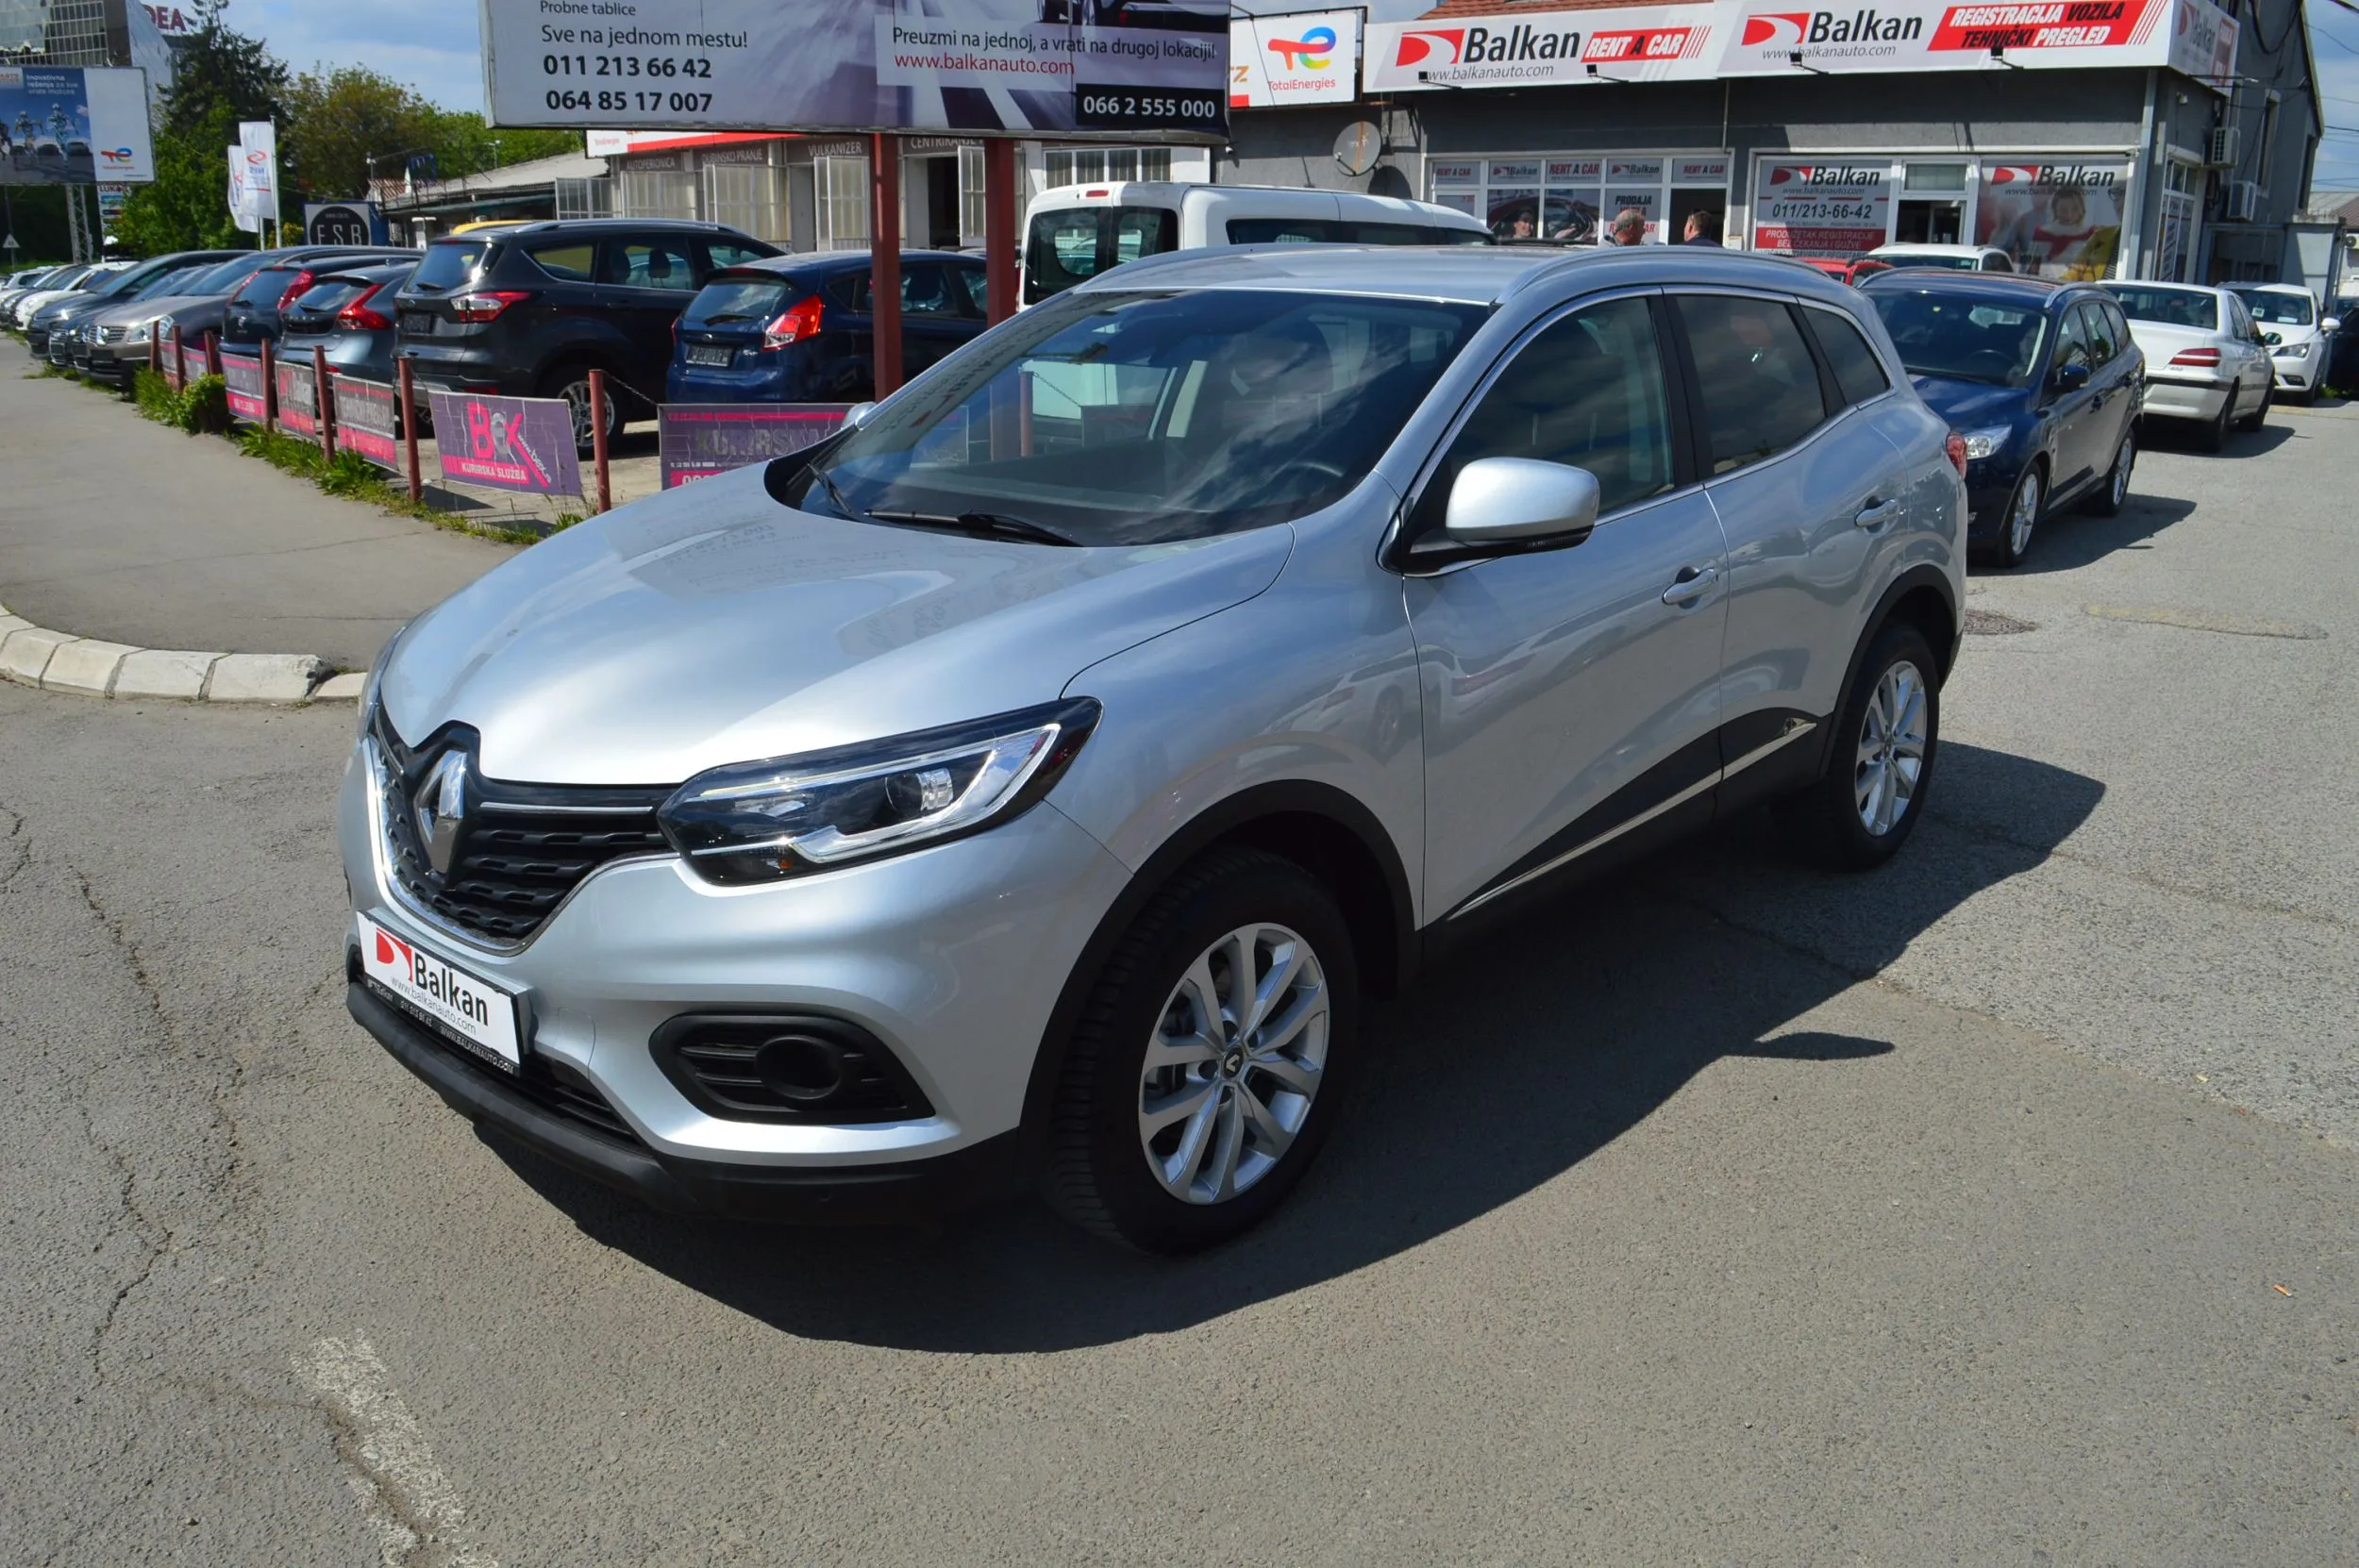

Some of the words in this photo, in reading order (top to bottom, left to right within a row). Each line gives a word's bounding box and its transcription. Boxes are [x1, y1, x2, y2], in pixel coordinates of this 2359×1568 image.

[540, 0, 589, 14] Probne
[593, 3, 636, 16] tablice
[1949, 4, 2065, 27] REGISTRACIJA
[2066, 2, 2125, 21] VOZILA
[1808, 9, 1922, 43] Balkan
[541, 25, 575, 43] Sve
[581, 30, 603, 43] na
[608, 26, 680, 48] jednom
[686, 31, 748, 48] mestu!
[893, 27, 956, 46] Preuzmi
[962, 33, 980, 47] na
[983, 32, 1036, 53] jednoj,
[1040, 38, 1048, 51] a
[1053, 38, 1086, 53] vrati
[1090, 41, 1107, 54] na
[1112, 38, 1159, 60] drugoj
[1163, 42, 1215, 63] lokaciji!
[1464, 25, 1581, 64] Balkan
[1585, 36, 1633, 58] RENT
[1630, 35, 1645, 55] A
[1646, 34, 1685, 56] CAR
[1961, 25, 2033, 48] TEHNIČKI
[2033, 25, 2111, 47] PREGLED
[1763, 45, 1896, 59] wwwbalkanauto.com
[544, 55, 586, 75] 011
[596, 56, 640, 77] 213
[647, 58, 677, 78] 66
[682, 58, 712, 79] 42
[895, 52, 1074, 76] www.balkanauto.com
[1230, 65, 1249, 83] Z
[1422, 64, 1554, 82] ww.balkanauto.com
[1268, 78, 1336, 92] TotalEnergies
[546, 90, 592, 110] 064
[598, 91, 627, 111] 85
[635, 92, 662, 112] 17
[669, 92, 713, 112] 007
[1084, 96, 1120, 115] 066
[1124, 97, 1136, 115] 2
[1141, 98, 1176, 117] 555
[1181, 100, 1215, 118] 000
[736, 149, 763, 161] PRANJE
[808, 142, 862, 157] VULKANIZER
[1510, 166, 1538, 175] Balkan
[1549, 164, 1572, 175] RENT
[1573, 164, 1580, 174] A
[1581, 164, 1600, 175] CAR
[1630, 164, 1659, 174] Balkan
[1683, 165, 1702, 174] RENT
[1703, 165, 1709, 173] A
[1710, 165, 1724, 174] CAR
[1812, 166, 1880, 186] Balkan
[2037, 166, 2115, 186] Balkan
[1615, 195, 1653, 206] PRODAJA
[1773, 204, 1872, 219] 011/213-66-42
[1777, 239, 1792, 248] BEZ
[497, 465, 527, 481] SLUŽBA
[415, 952, 489, 1026] Balkan
[391, 975, 477, 1036] www.balkanauto.com
[440, 1026, 514, 1074] WWW.BALKANAUTO.COM
